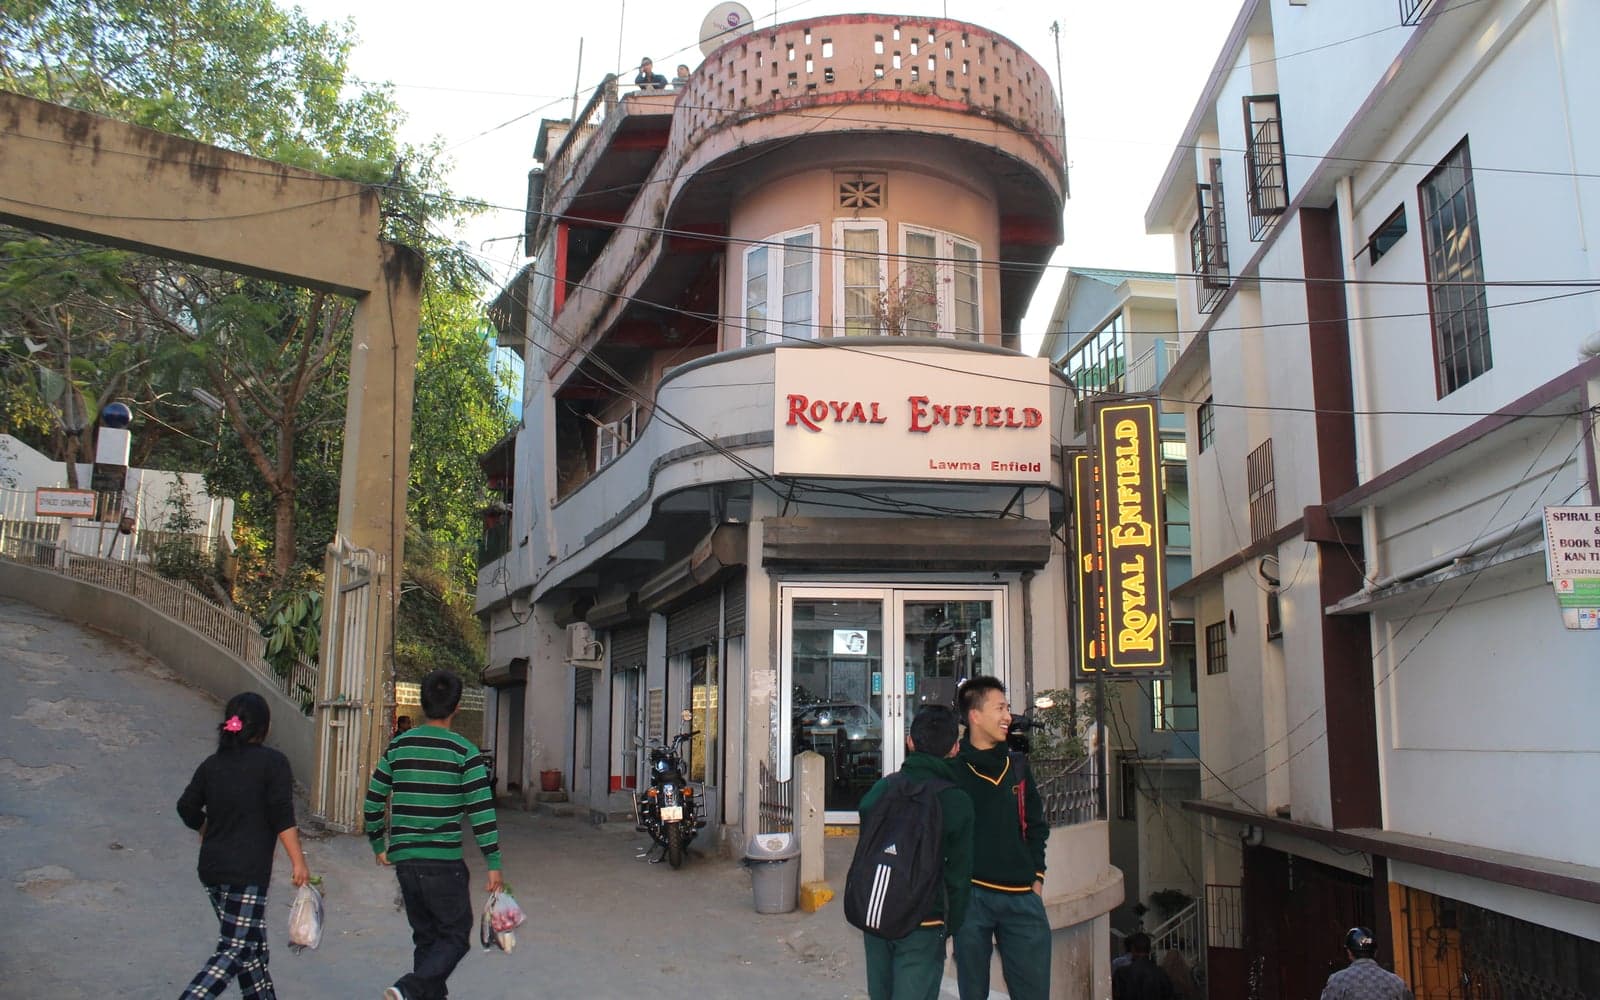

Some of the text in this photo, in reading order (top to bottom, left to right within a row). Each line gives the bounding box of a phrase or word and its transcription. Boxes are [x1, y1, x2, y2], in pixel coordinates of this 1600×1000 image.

[786, 394, 1043, 433] ROYAL ENFIELD
[929, 459, 1041, 472] Lawma Enfield
[1552, 512, 1592, 521] SPIRAL
[1111, 419, 1158, 653] ROYAL ENFIELD
[1559, 539, 1591, 548] BOOK
[1564, 552, 1586, 561] KAN
